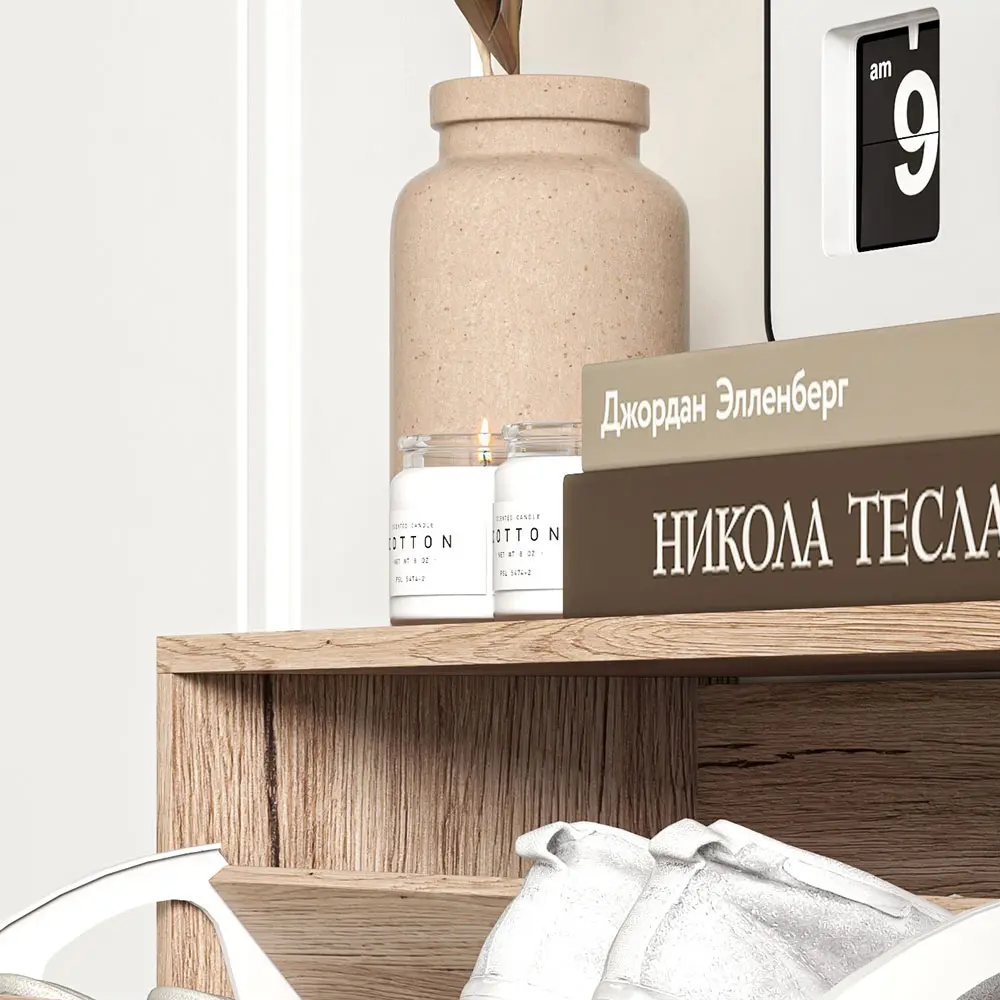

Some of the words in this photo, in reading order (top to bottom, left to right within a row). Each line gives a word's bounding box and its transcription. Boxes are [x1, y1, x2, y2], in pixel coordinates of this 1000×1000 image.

[870, 59, 892, 81] am
[893, 69, 939, 196] 9
[600, 389, 706, 439] Джордан
[716, 368, 849, 421] Элленберг
[653, 498, 833, 578] НИКОЛА
